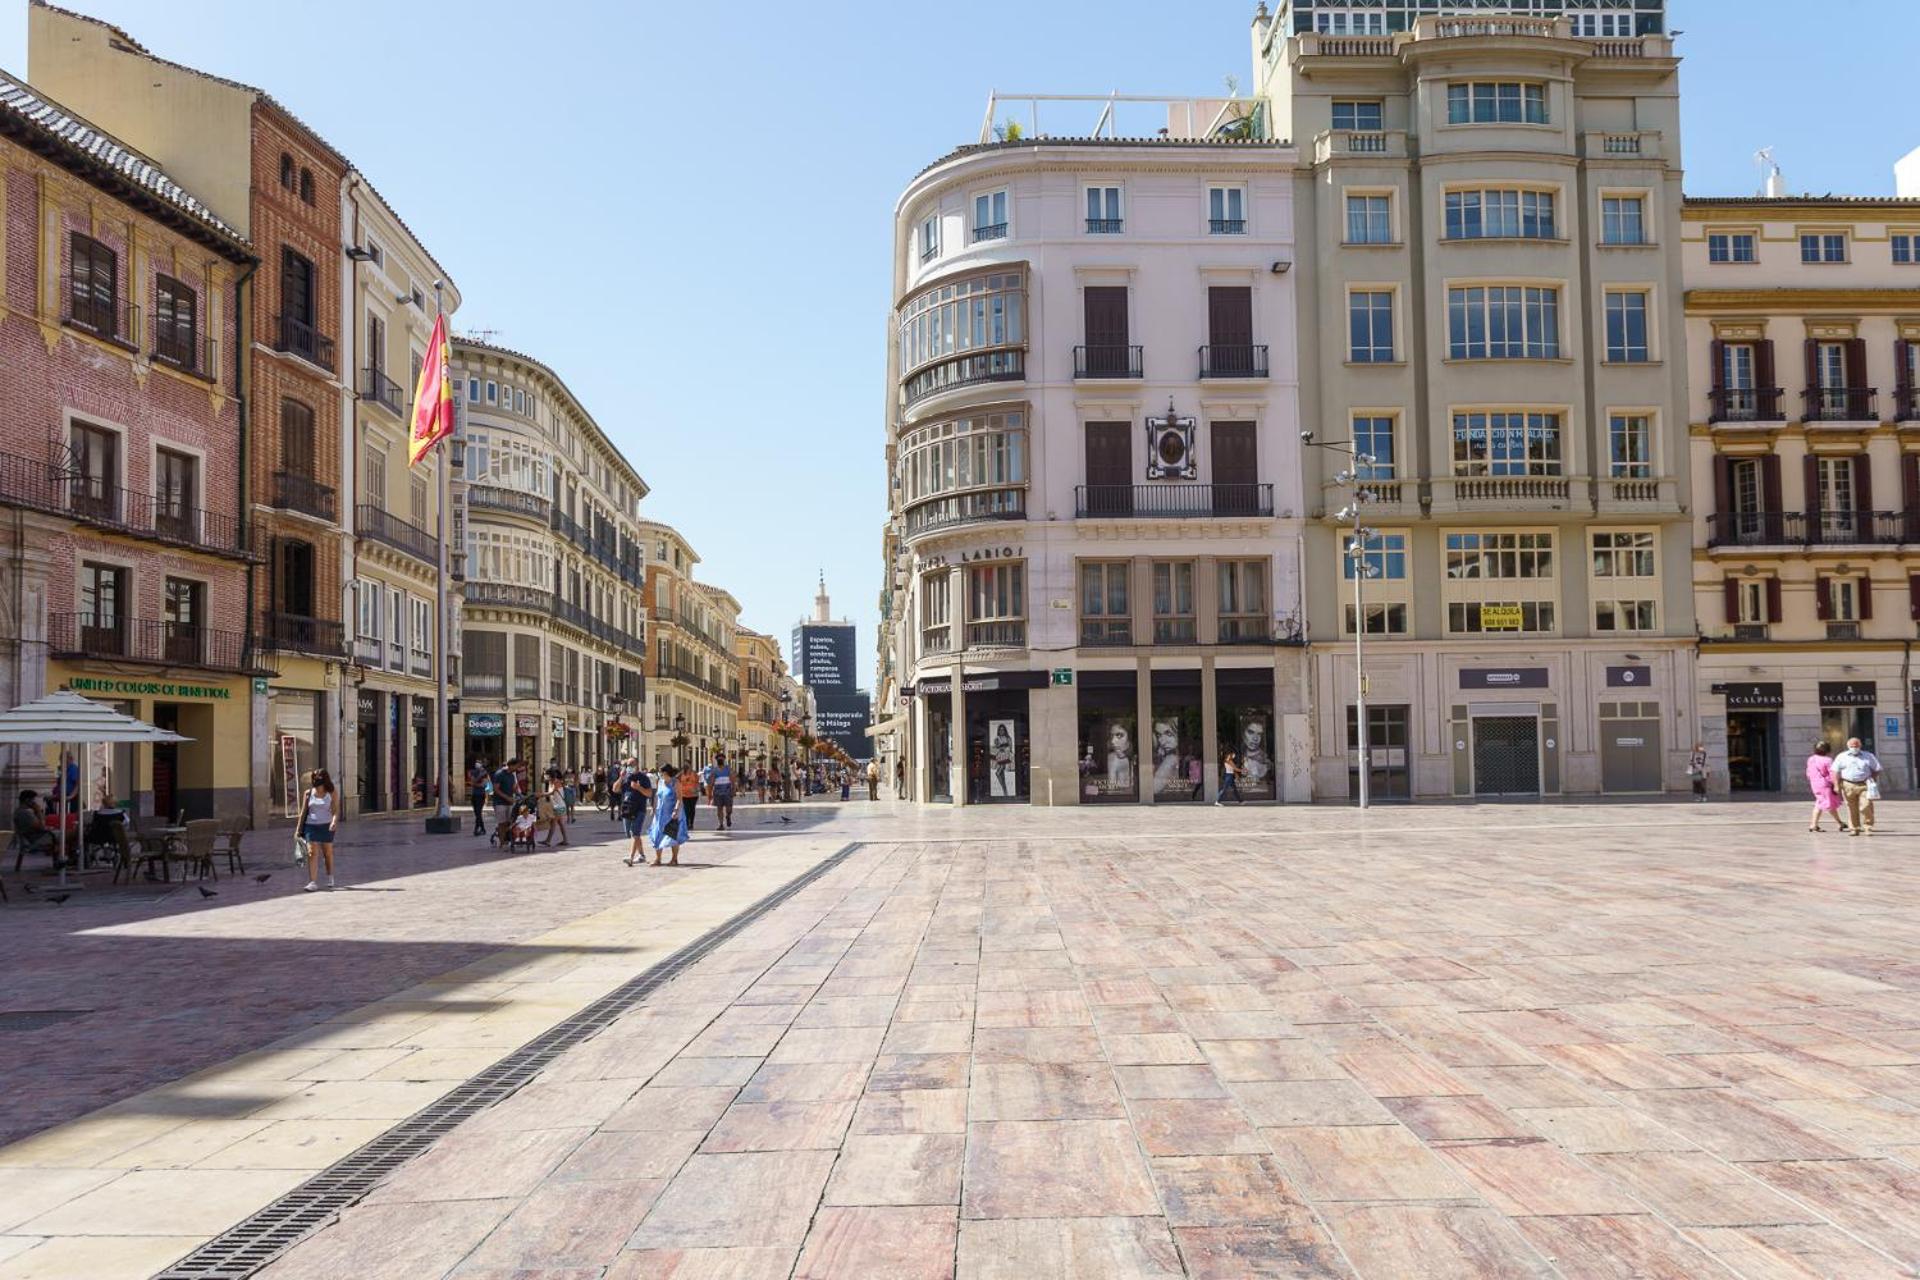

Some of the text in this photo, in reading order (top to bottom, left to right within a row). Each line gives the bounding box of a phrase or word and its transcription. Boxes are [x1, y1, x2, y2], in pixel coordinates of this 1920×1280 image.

[69, 677, 114, 691] UNITED
[115, 680, 161, 695] COLORS
[162, 683, 174, 696] OF
[1730, 695, 1783, 704] SCALPERS
[469, 719, 503, 729] Desigual
